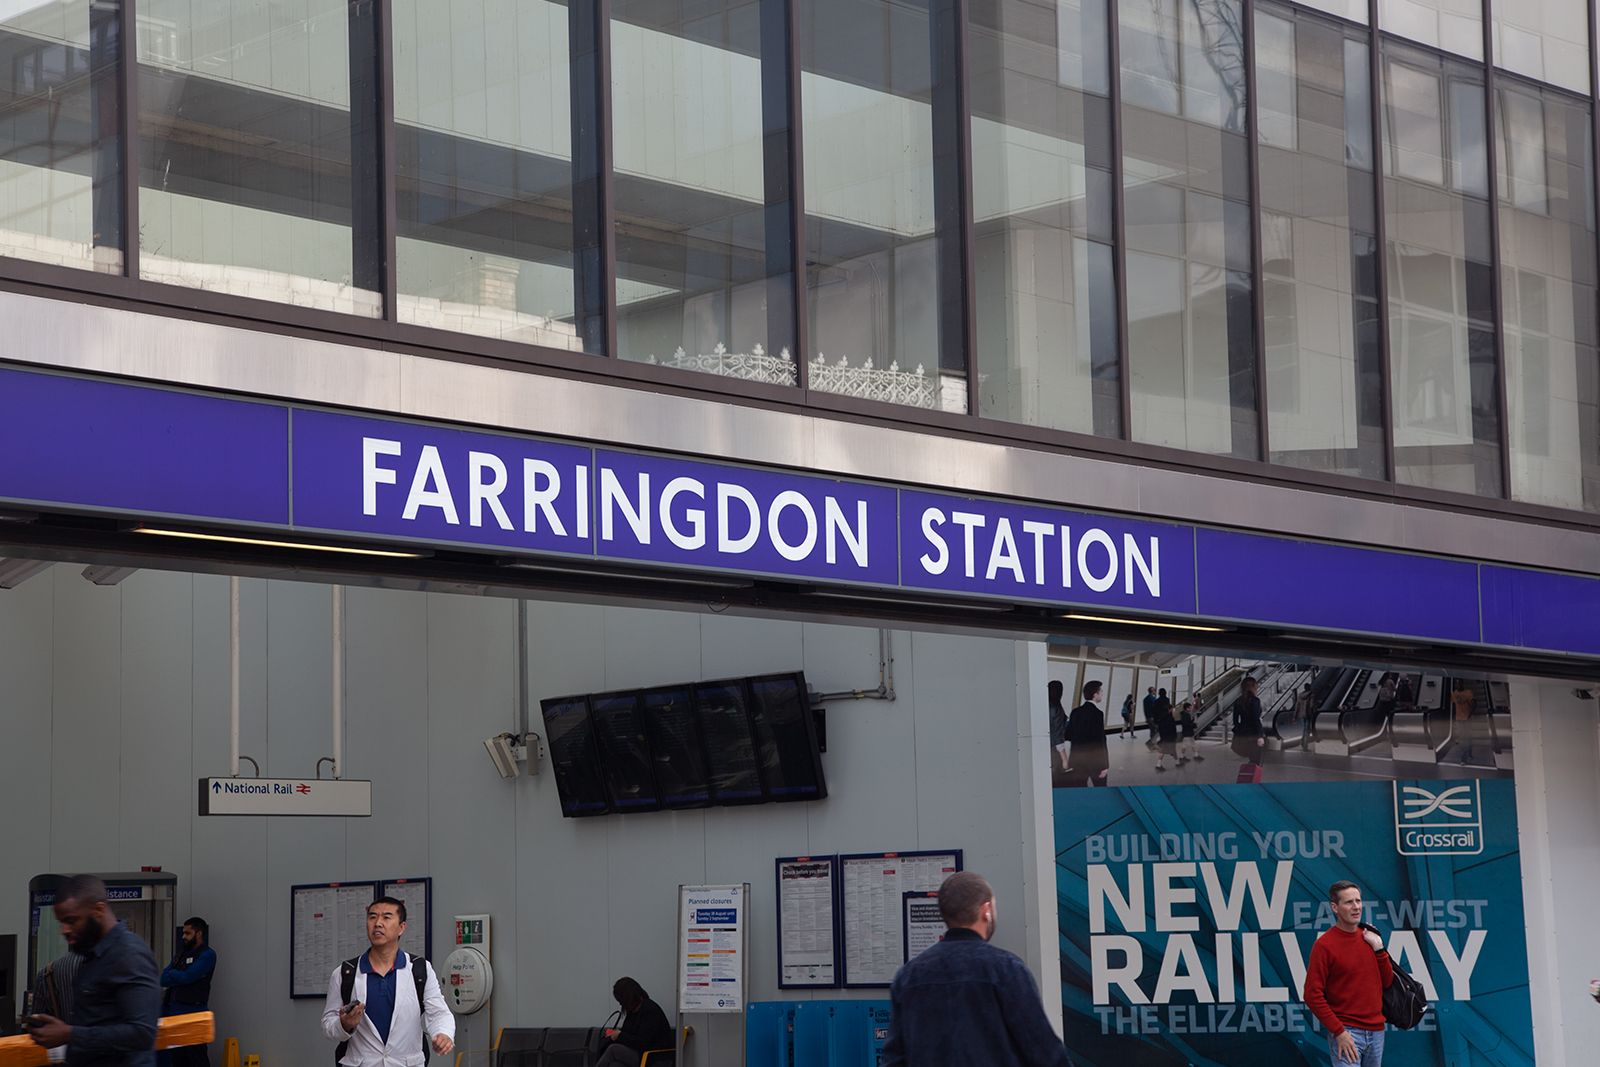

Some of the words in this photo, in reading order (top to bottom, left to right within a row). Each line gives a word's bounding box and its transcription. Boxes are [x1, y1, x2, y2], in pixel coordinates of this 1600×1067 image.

[363, 437, 868, 568] FARRINGDON
[920, 508, 1160, 598] STATION
[224, 782, 270, 795] National
[273, 784, 293, 795] Rail
[1086, 832, 1239, 863] BUILDING
[1253, 829, 1347, 859] YOUR
[1406, 831, 1474, 848] Crossrail
[34, 893, 56, 903] Assistan
[107, 890, 138, 899] istance
[1086, 860, 1294, 933] NEW
[1293, 899, 1488, 930] EAT-WEST
[1093, 1005, 1160, 1035] THE
[1169, 1002, 1323, 1034] ELIZABET
